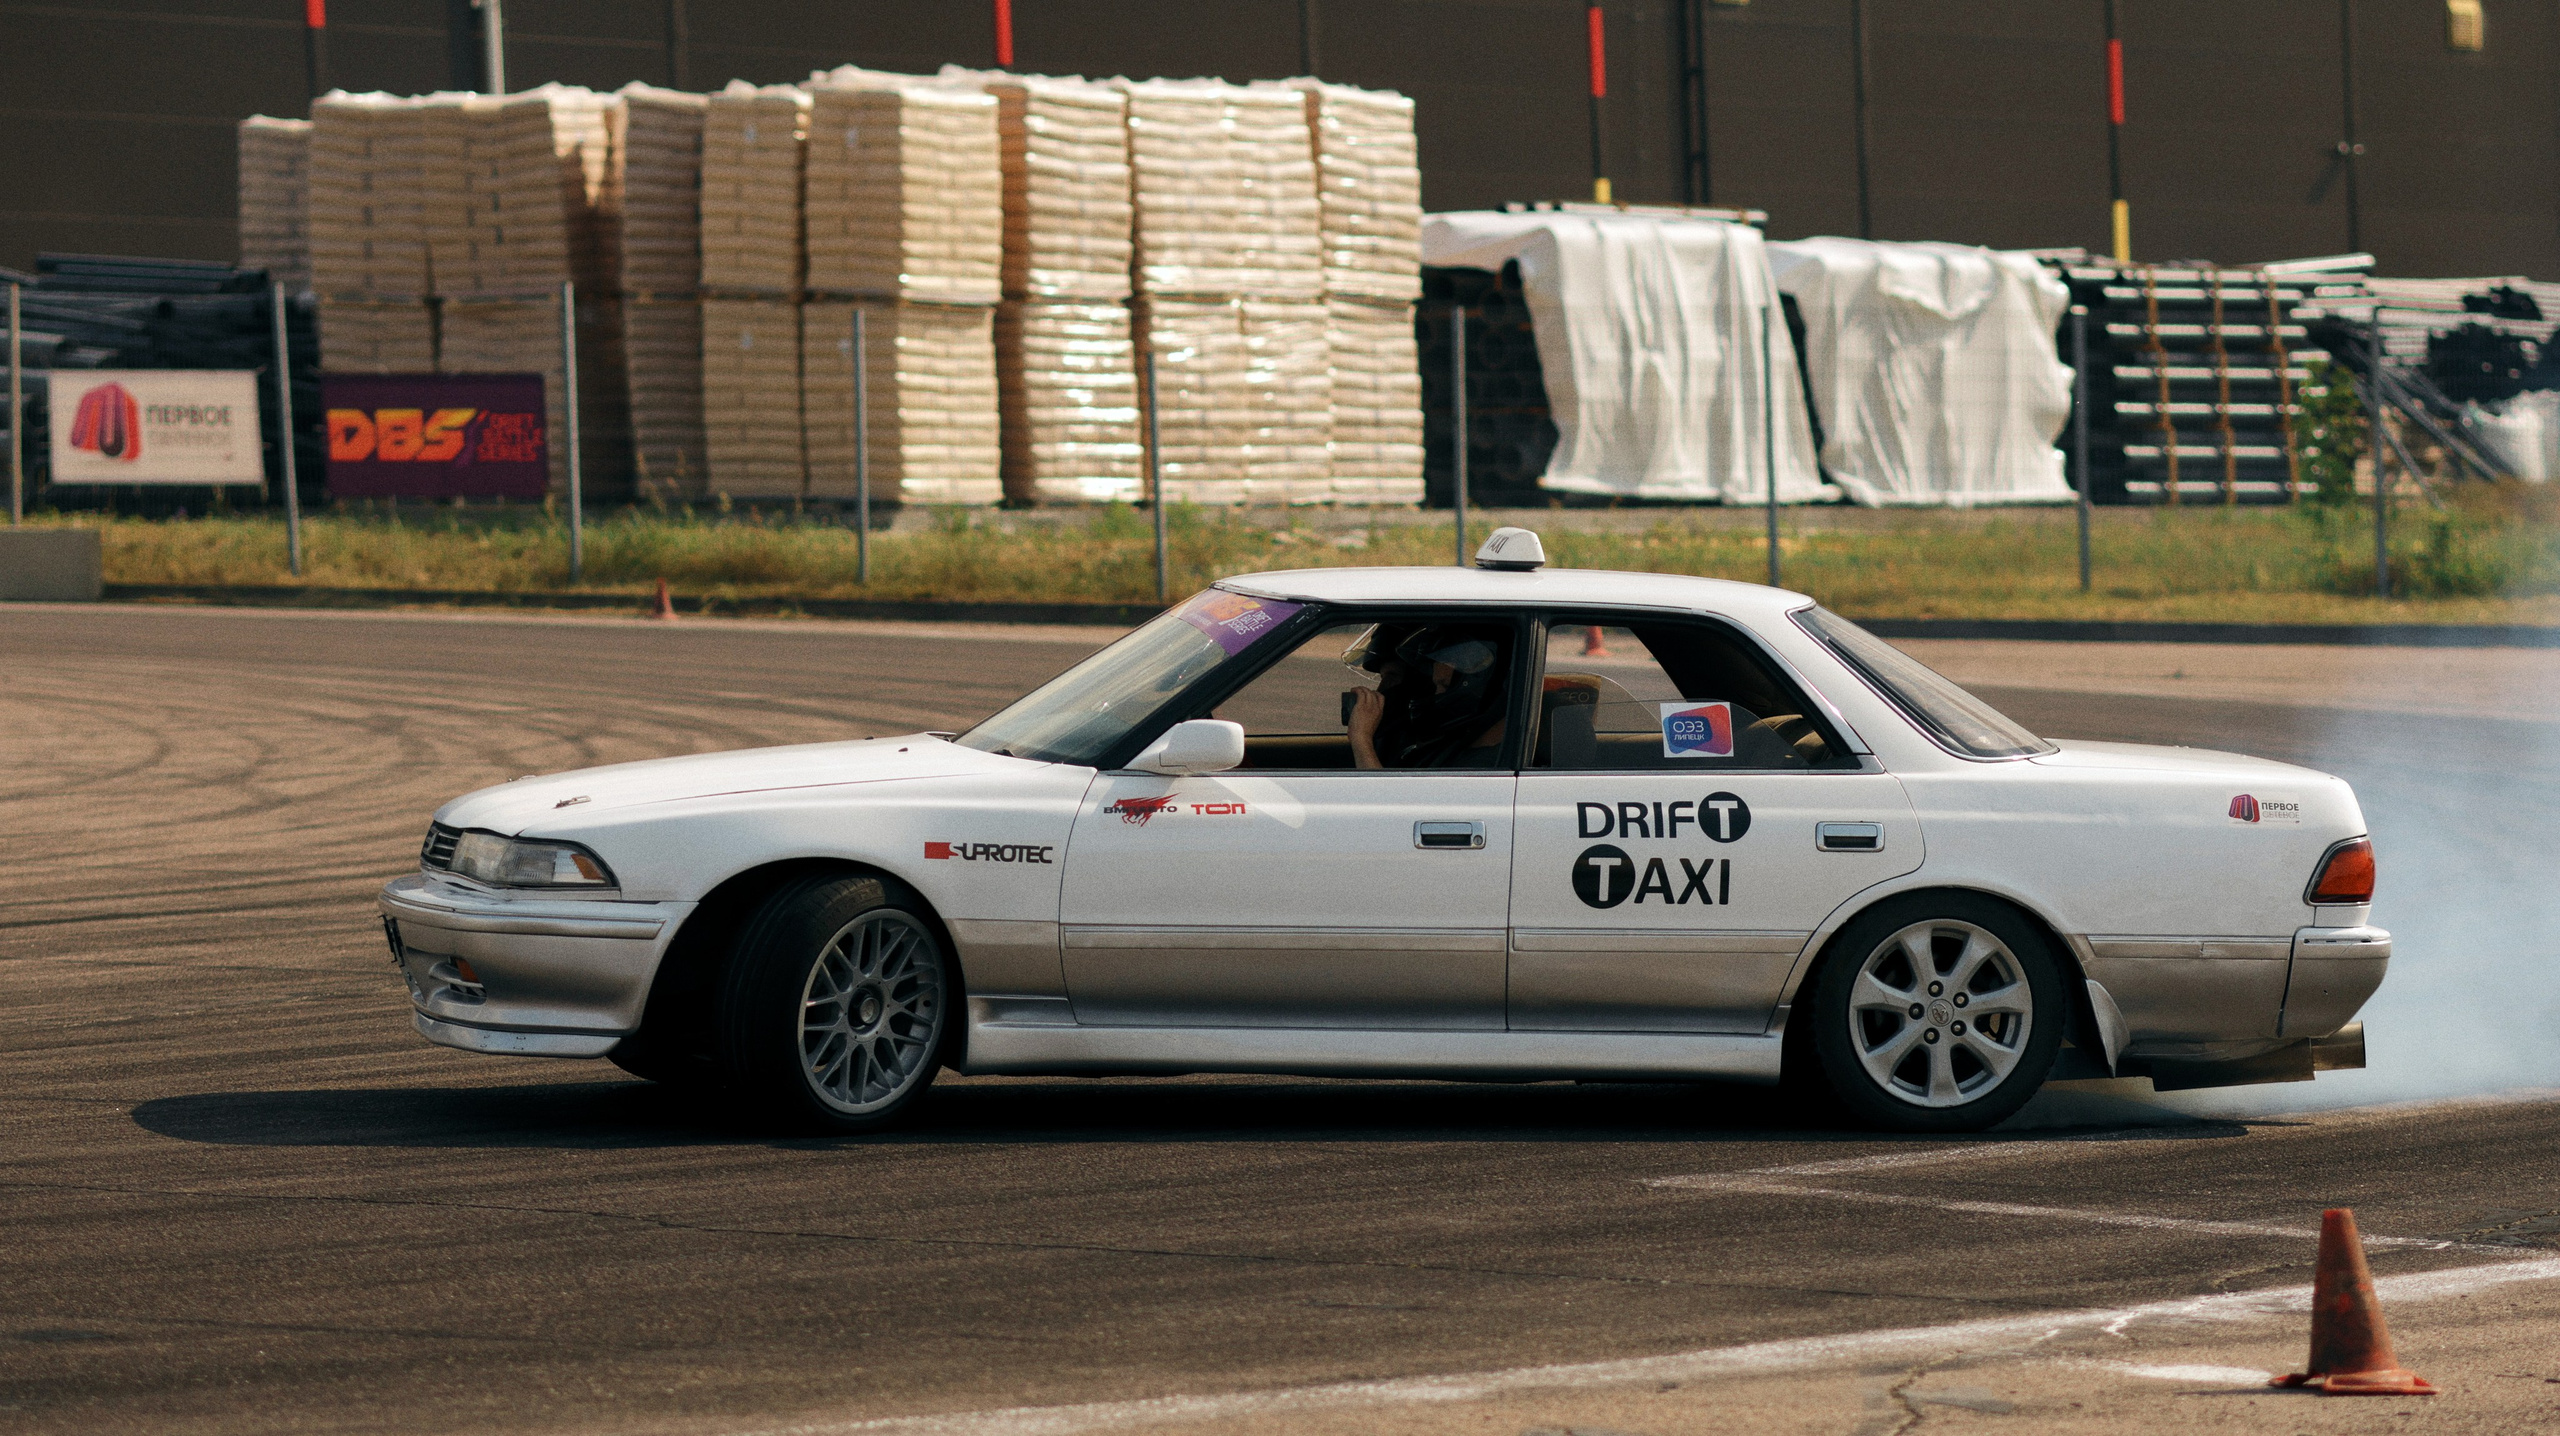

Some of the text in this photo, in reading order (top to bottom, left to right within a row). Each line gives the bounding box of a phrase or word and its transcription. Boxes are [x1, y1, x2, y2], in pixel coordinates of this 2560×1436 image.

[147, 405, 233, 426] ПЕРВОЕ
[327, 408, 477, 462] DBS
[1577, 791, 1751, 843] DRIFT
[2262, 803, 2299, 811] ПЕРВОЕ
[947, 842, 1053, 864] SUPROTEC
[1572, 844, 1730, 909] TAXI
